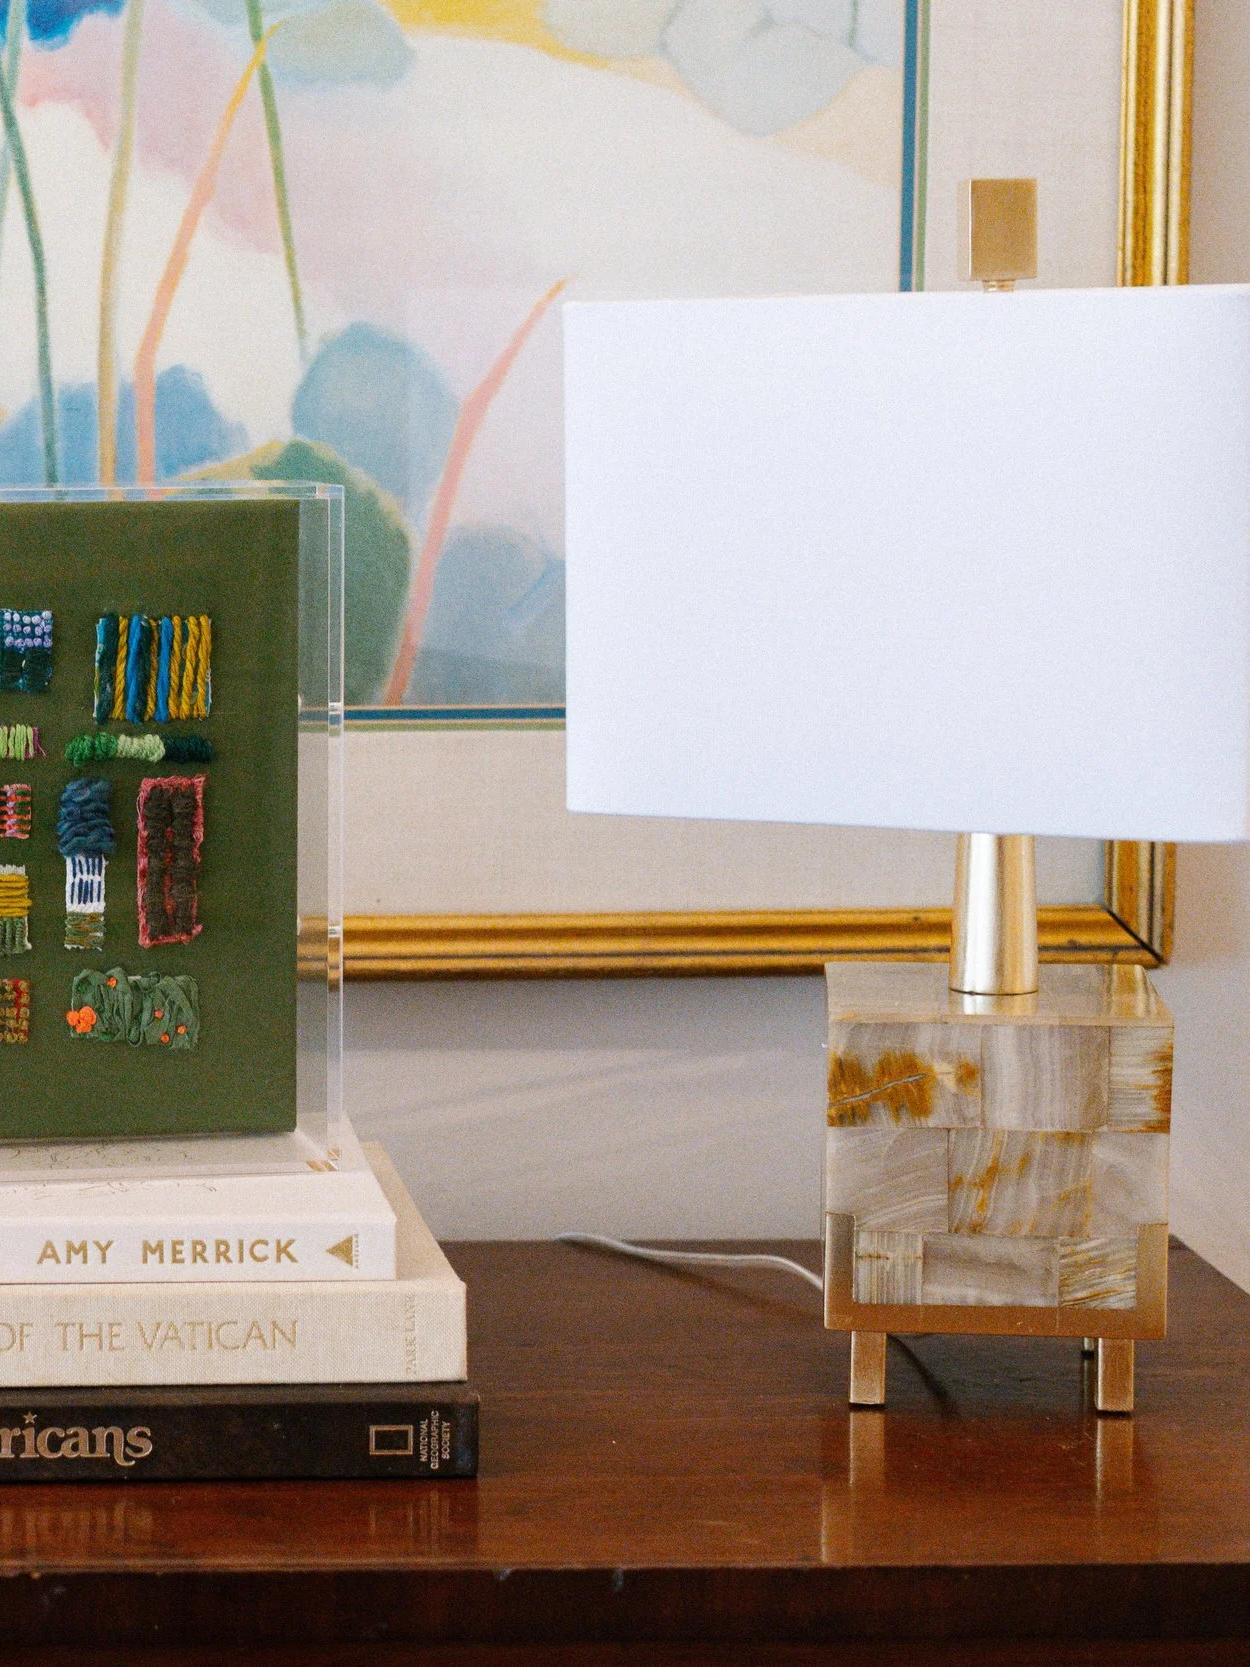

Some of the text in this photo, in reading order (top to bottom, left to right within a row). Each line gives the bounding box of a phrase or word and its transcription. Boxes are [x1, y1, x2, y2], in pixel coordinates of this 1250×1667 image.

[37, 1238, 299, 1265] AMY MERRICK
[55, 1321, 129, 1352] THE
[136, 1319, 300, 1352] VATICAN
[419, 1418, 429, 1462] NATIONAL
[430, 1410, 440, 1470] GEOGRAPHIC
[441, 1420, 451, 1460] SOCIETY
